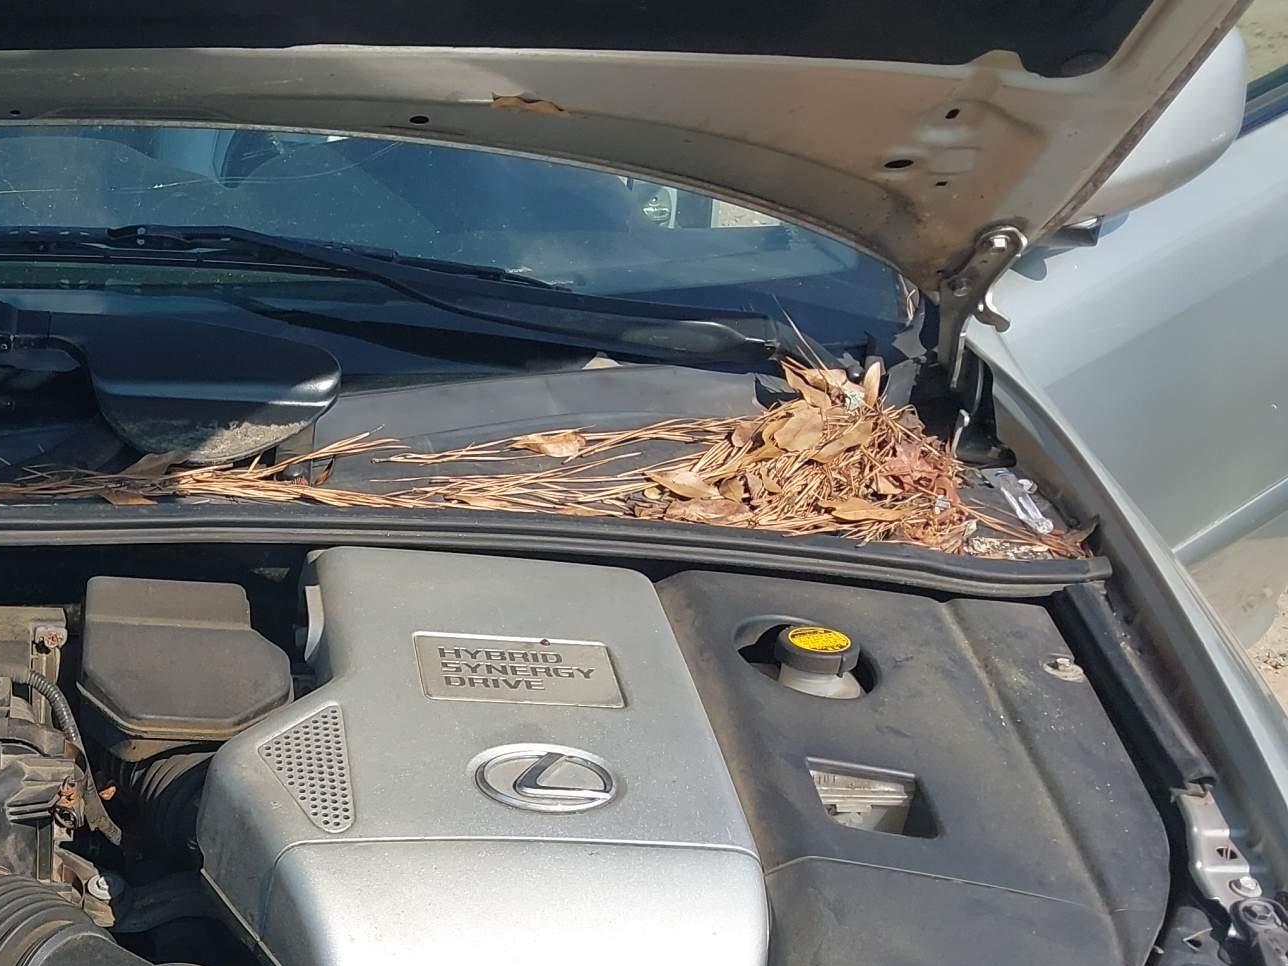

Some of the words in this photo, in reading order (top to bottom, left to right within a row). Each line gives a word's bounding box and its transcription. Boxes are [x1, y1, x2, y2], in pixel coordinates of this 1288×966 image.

[438, 647, 562, 664] HYBRID
[440, 661, 596, 679] SYNERGY
[443, 675, 545, 691] DRIVE
